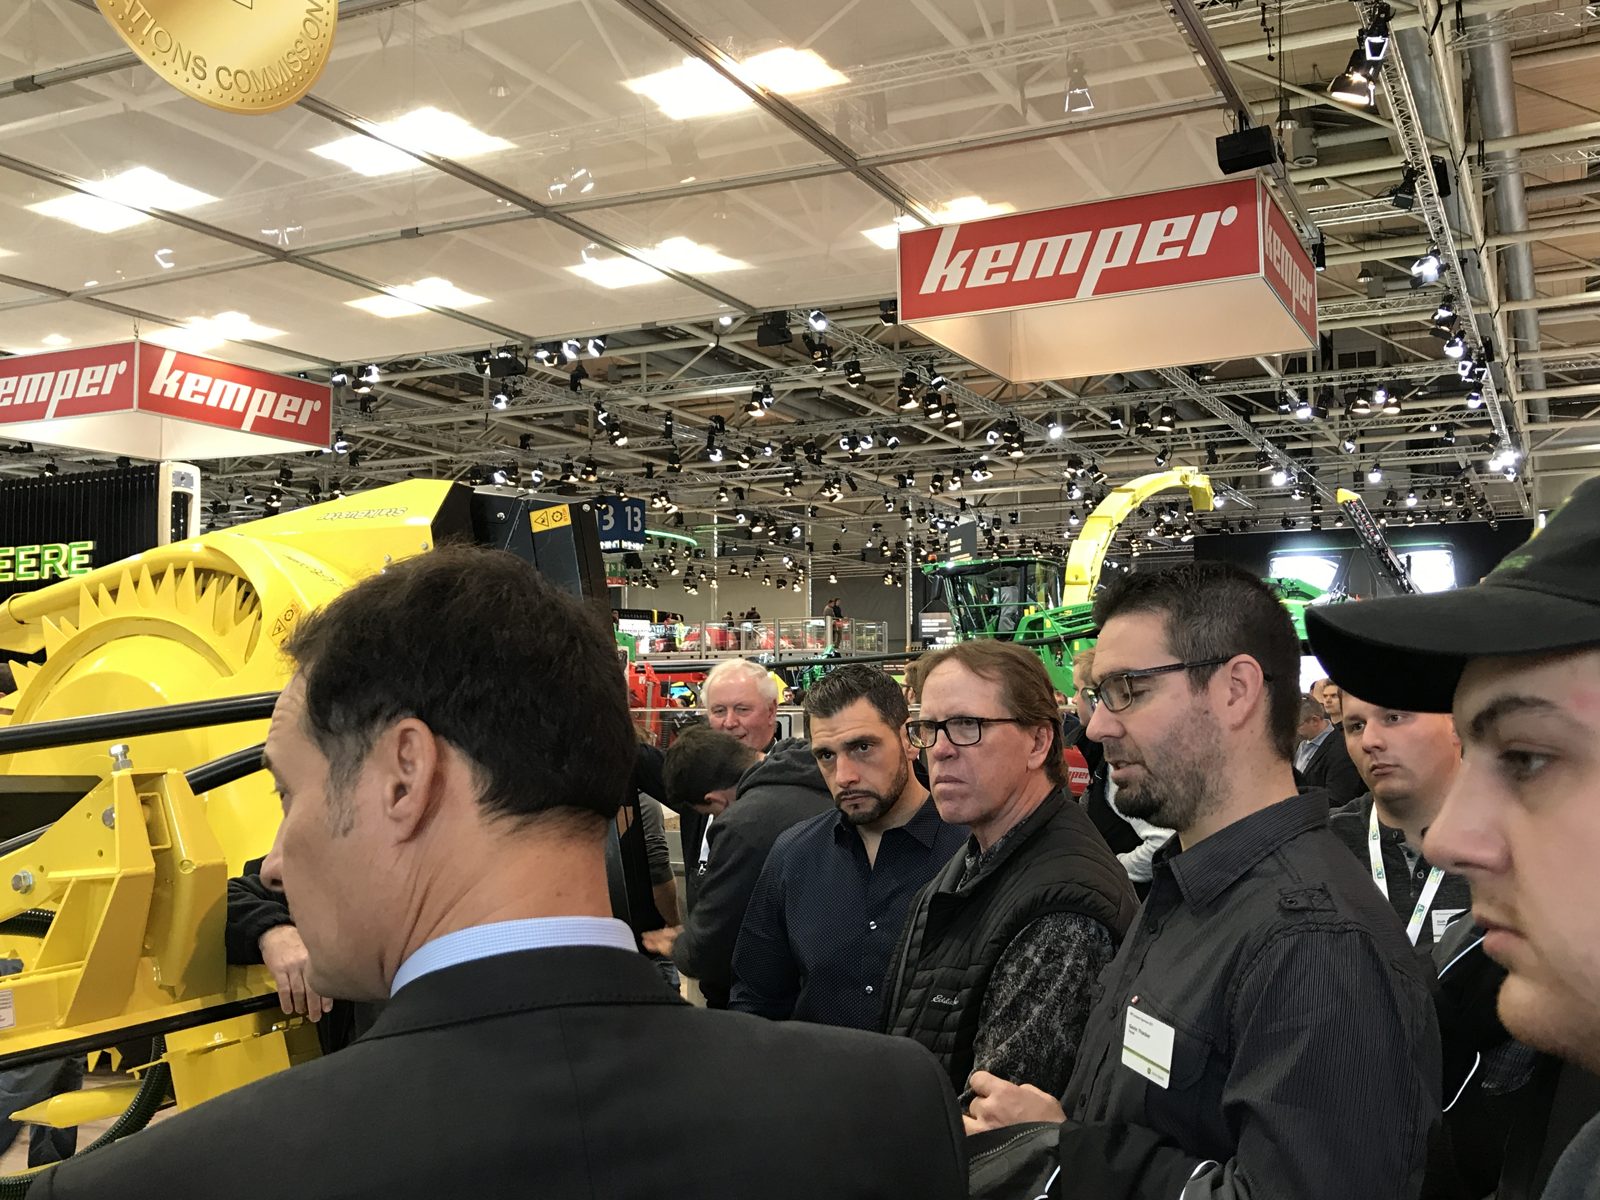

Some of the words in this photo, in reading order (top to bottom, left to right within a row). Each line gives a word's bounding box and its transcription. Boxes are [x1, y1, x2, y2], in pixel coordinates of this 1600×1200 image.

[215, 0, 324, 94] COMMISSION
[919, 206, 1238, 299] kemper
[1265, 192, 1313, 317] kemper
[0, 360, 127, 420] emper
[149, 349, 321, 431] kemper
[625, 500, 642, 532] 13
